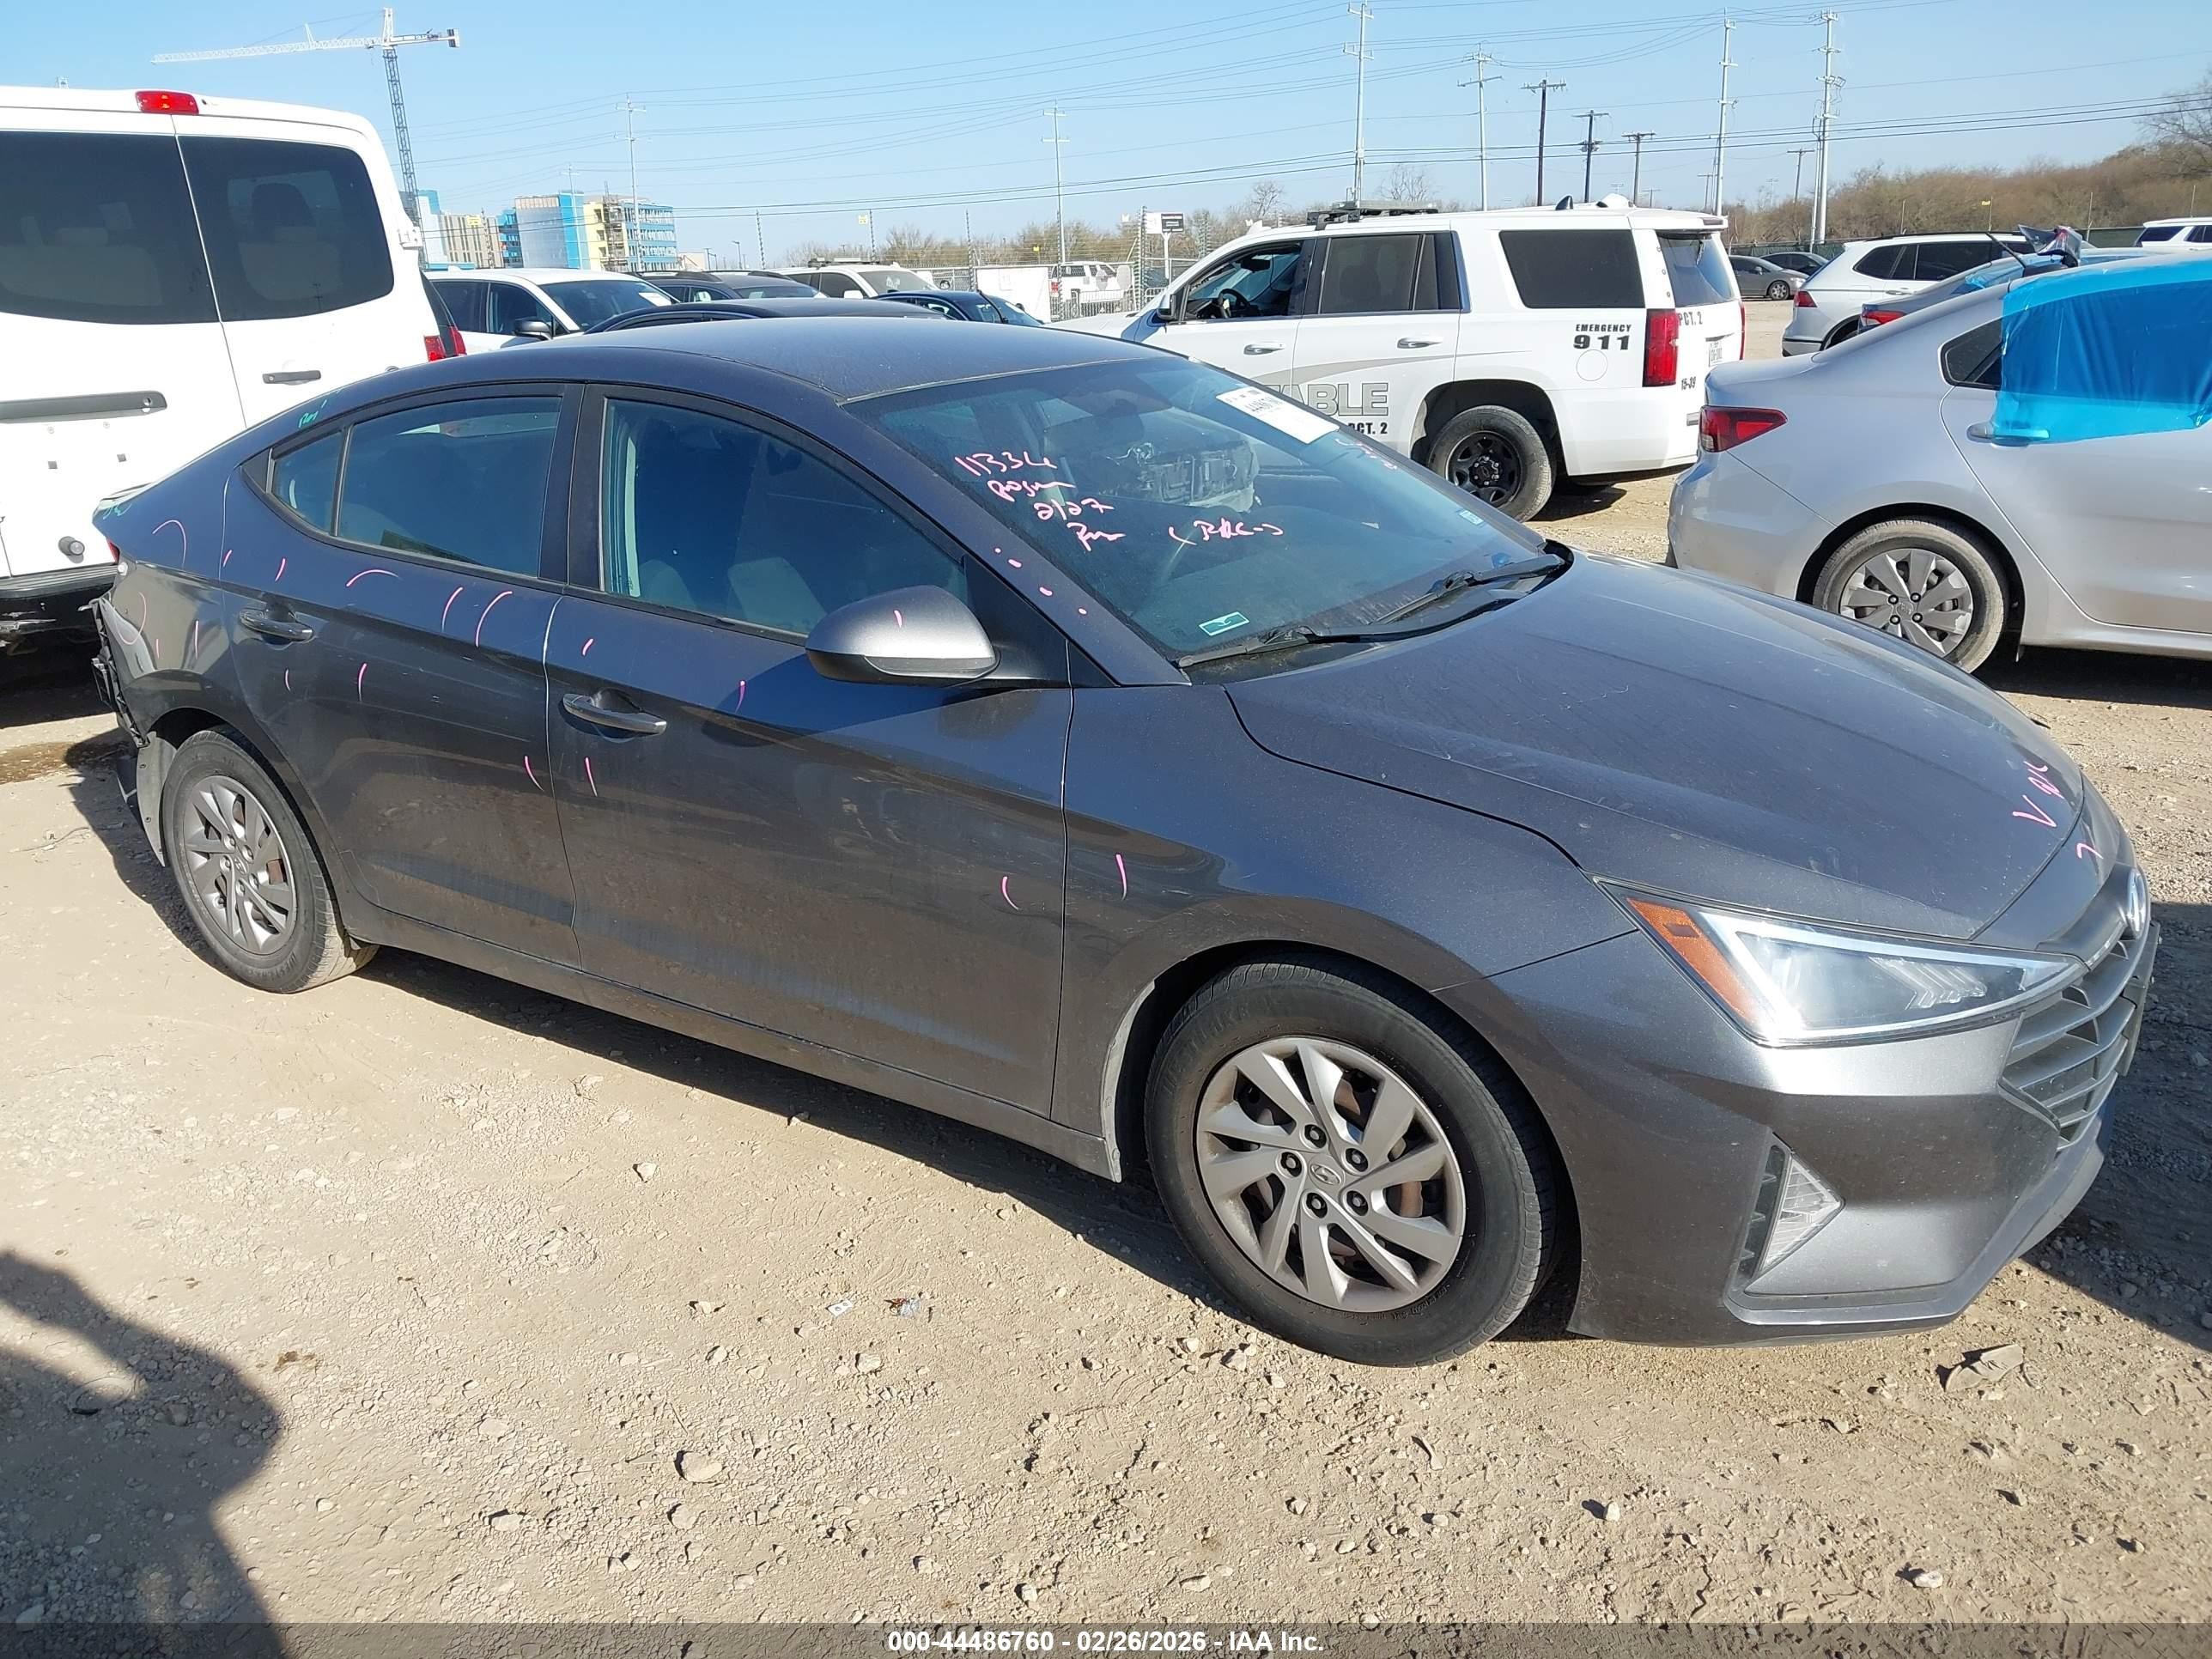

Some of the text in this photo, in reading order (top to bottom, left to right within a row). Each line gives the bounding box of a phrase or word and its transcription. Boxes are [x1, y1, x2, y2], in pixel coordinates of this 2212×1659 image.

[1698, 311, 1704, 325] 2
[1575, 324, 1632, 332] EMERGENCY
[1573, 334, 1630, 350] 911
[1380, 422, 1388, 434] 2
